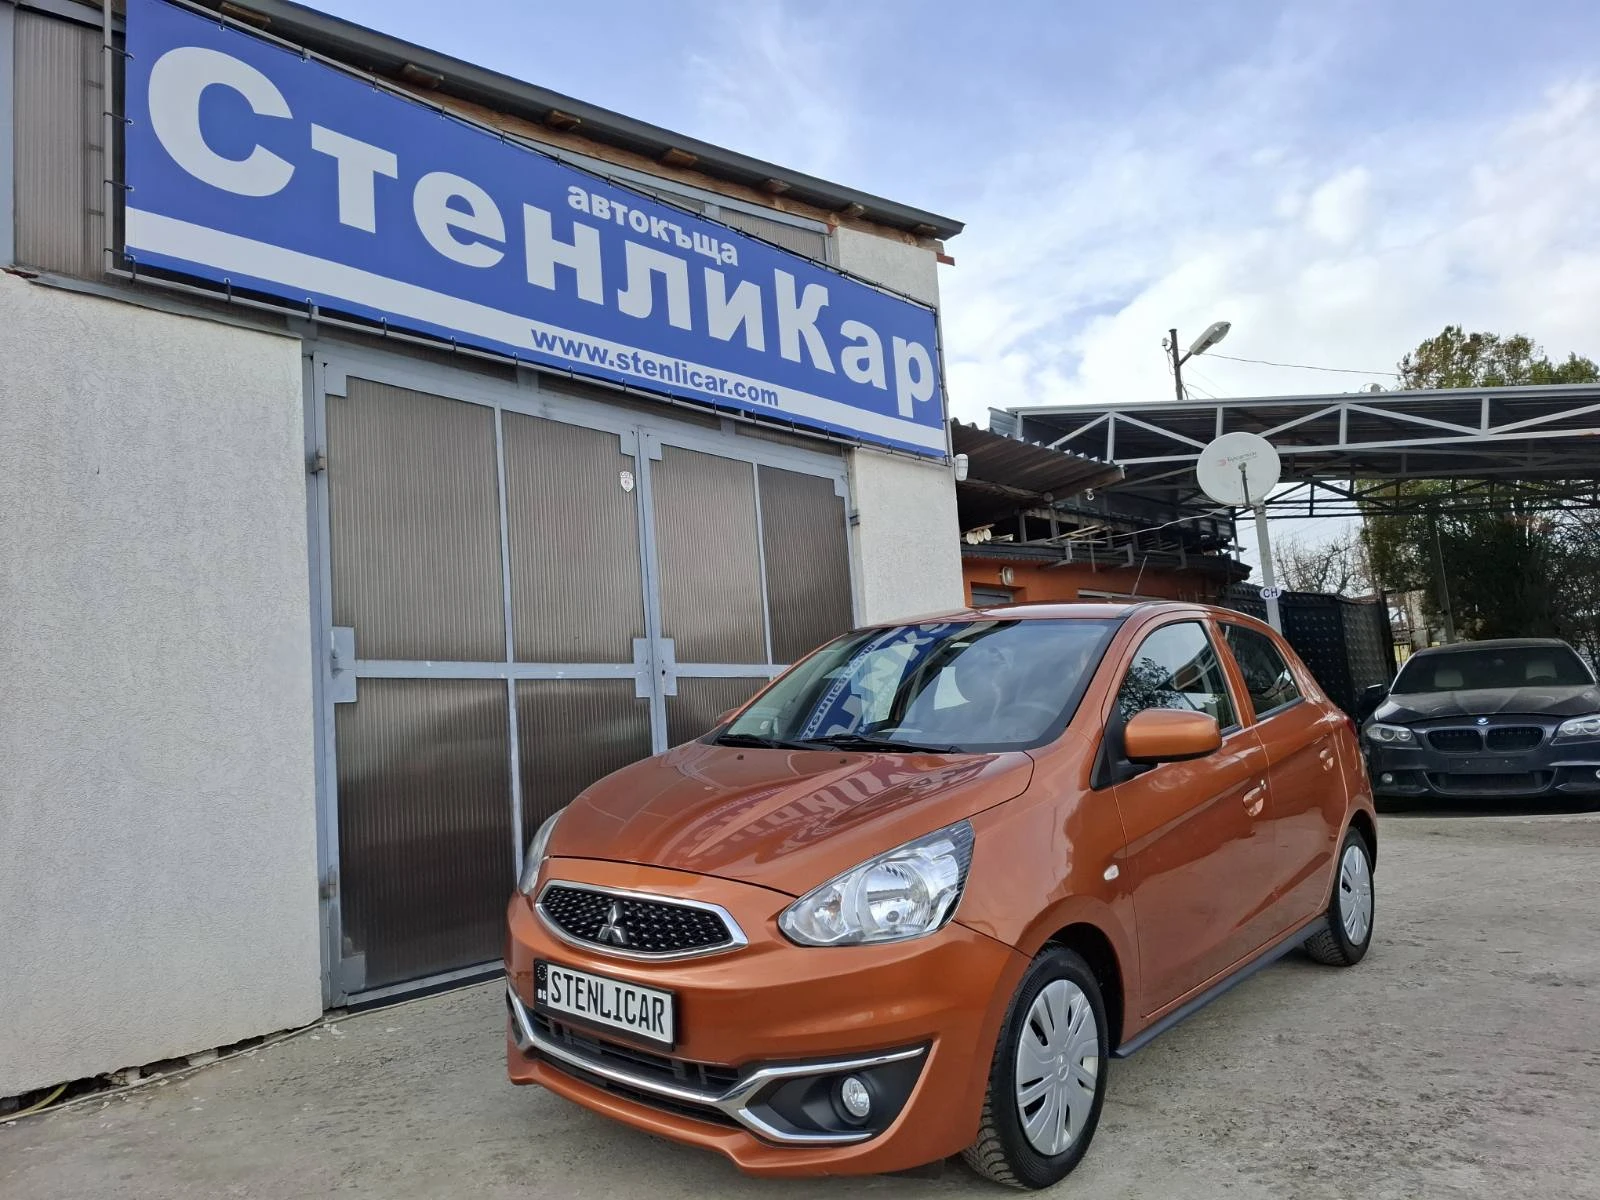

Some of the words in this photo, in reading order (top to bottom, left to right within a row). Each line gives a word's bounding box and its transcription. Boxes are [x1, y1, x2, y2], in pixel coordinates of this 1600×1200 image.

[148, 46, 935, 419] СтенлиКар
[567, 185, 738, 266] автокъща
[531, 328, 779, 407] www.stenlicar.com
[1263, 588, 1278, 598] CH
[551, 971, 665, 1035] STENLICAR
